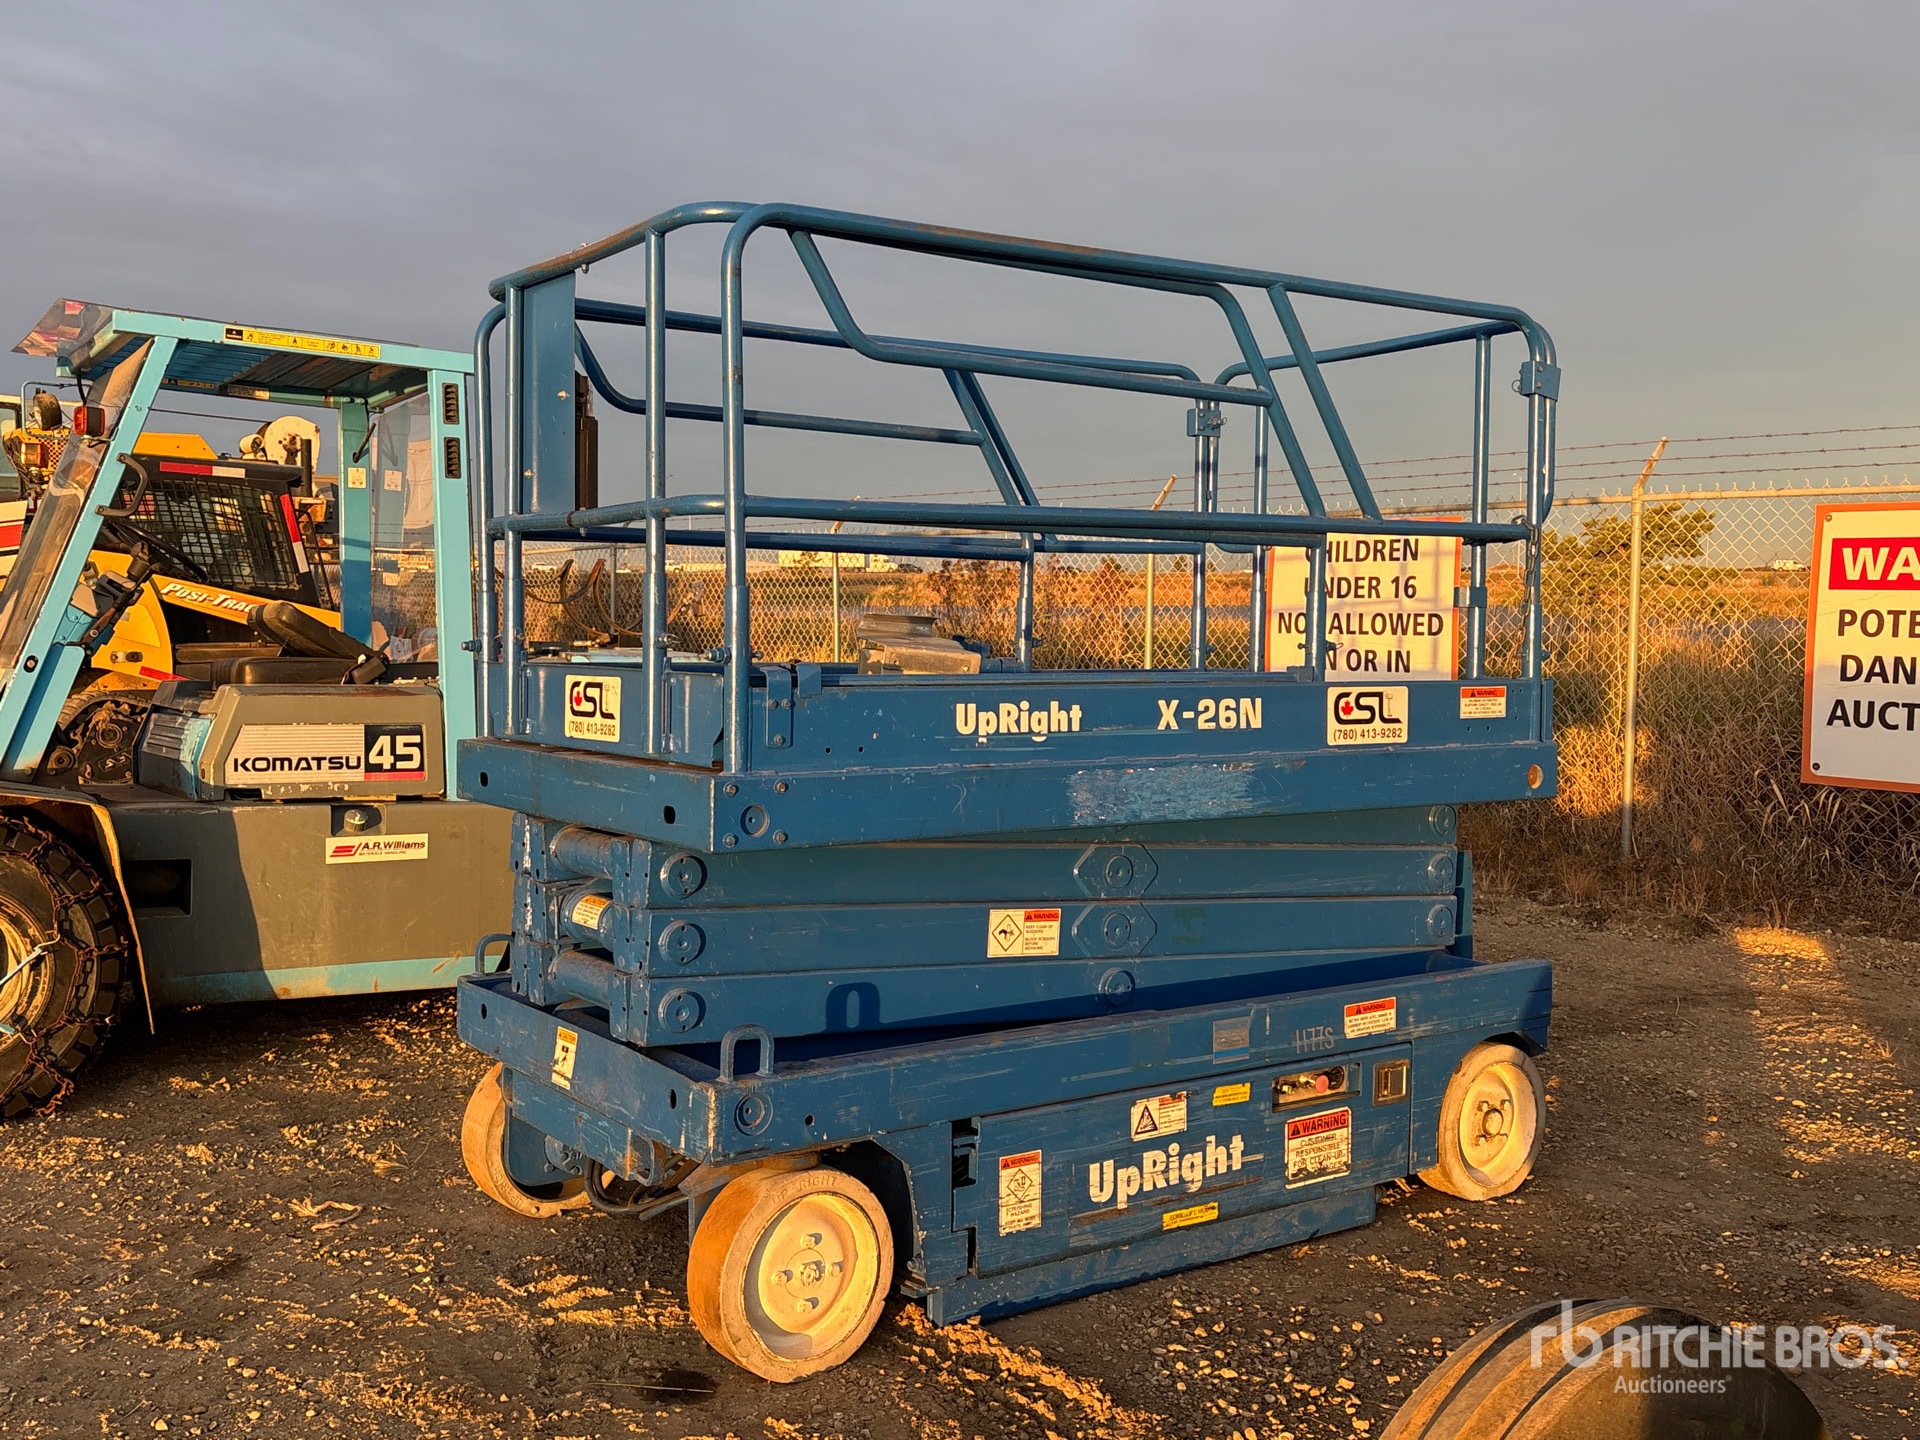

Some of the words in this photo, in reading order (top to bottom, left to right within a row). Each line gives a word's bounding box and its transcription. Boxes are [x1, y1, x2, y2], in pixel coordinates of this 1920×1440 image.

[1391, 575, 1418, 599] 16
[1328, 612, 1444, 636] ALLOWED
[1346, 649, 1378, 672] OR
[1387, 650, 1411, 673] IN
[570, 681, 616, 720] CSL
[1334, 691, 1403, 725] CSL
[956, 700, 1082, 743] UpRight
[1157, 698, 1263, 730] X-26N
[569, 721, 585, 736] (780)
[586, 723, 616, 737] 413-9282
[1333, 728, 1358, 742] (780)
[1360, 727, 1403, 740] 413-9282
[233, 756, 362, 773] KOMATSU
[368, 735, 421, 770] 45
[1302, 1113, 1346, 1134] WARNING
[1089, 1134, 1245, 1209] UpRight
